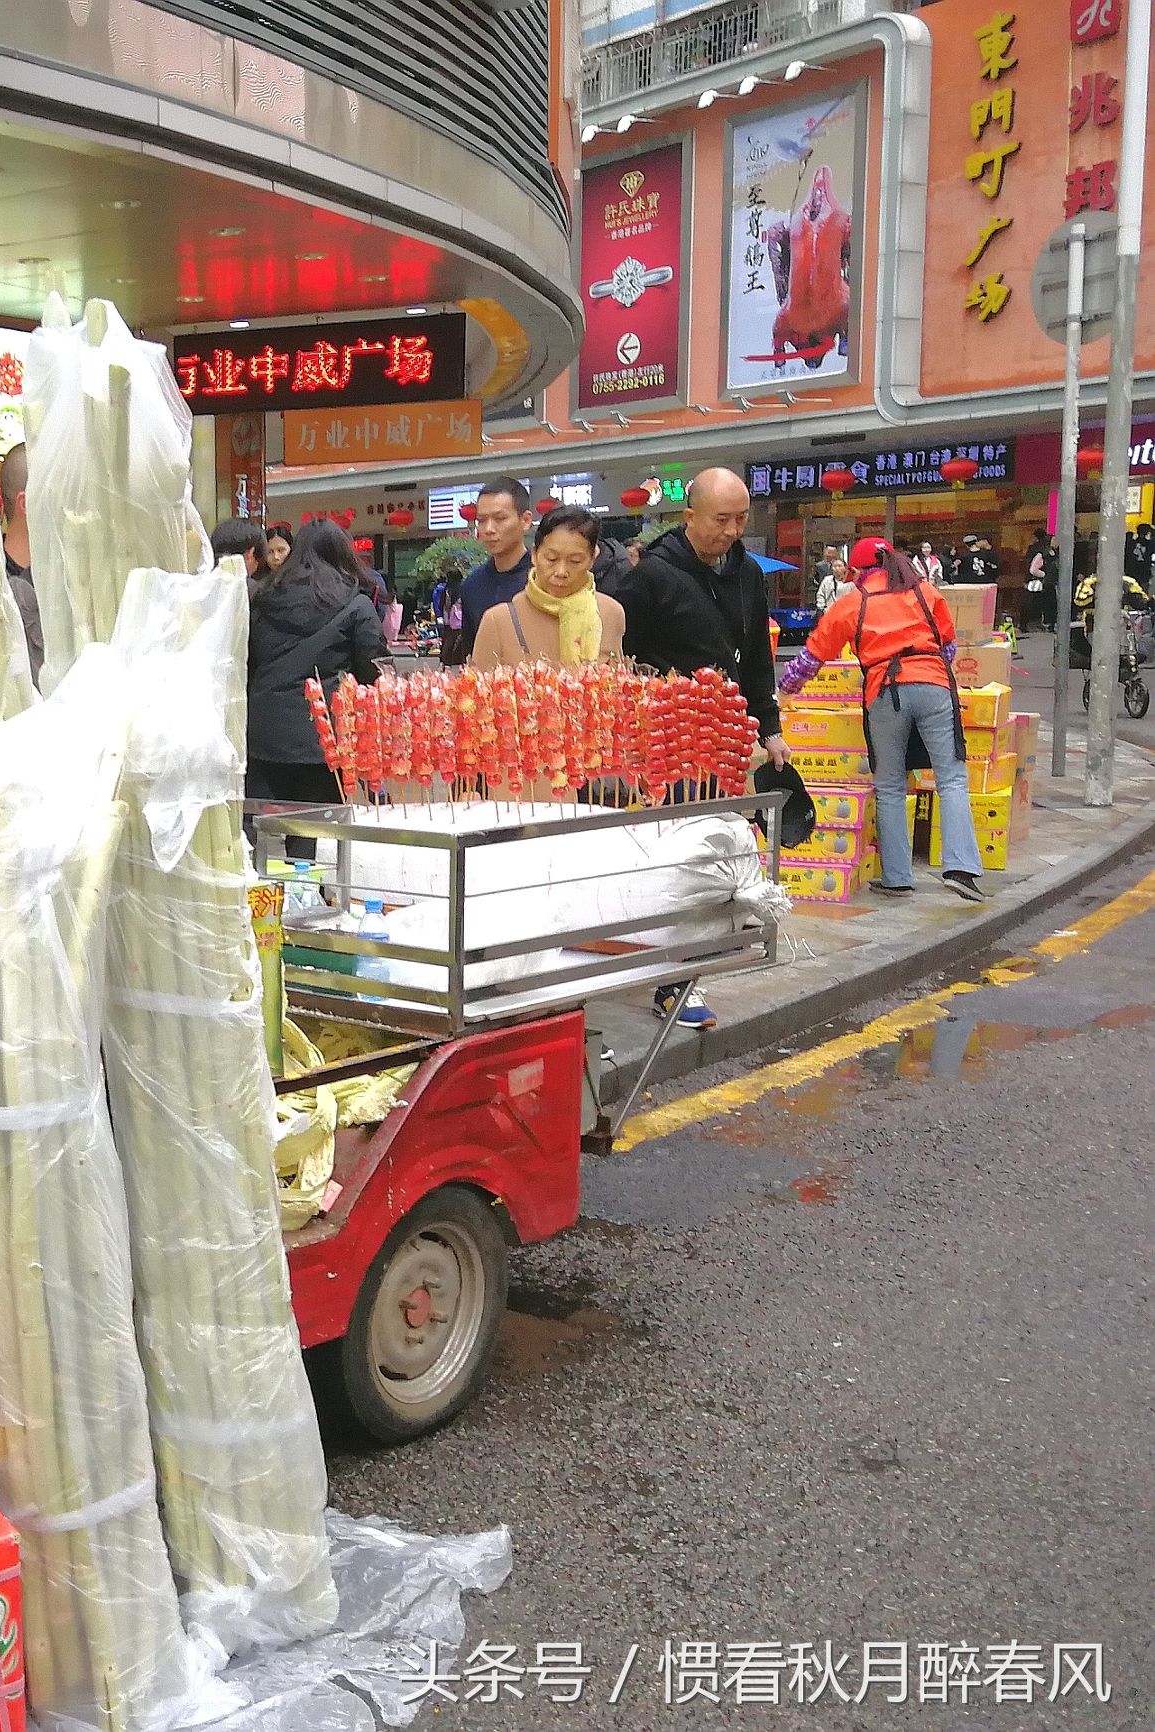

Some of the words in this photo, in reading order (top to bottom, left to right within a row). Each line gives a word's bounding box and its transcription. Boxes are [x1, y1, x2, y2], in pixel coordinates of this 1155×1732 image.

[297, 413, 473, 452] 万业中威广场
